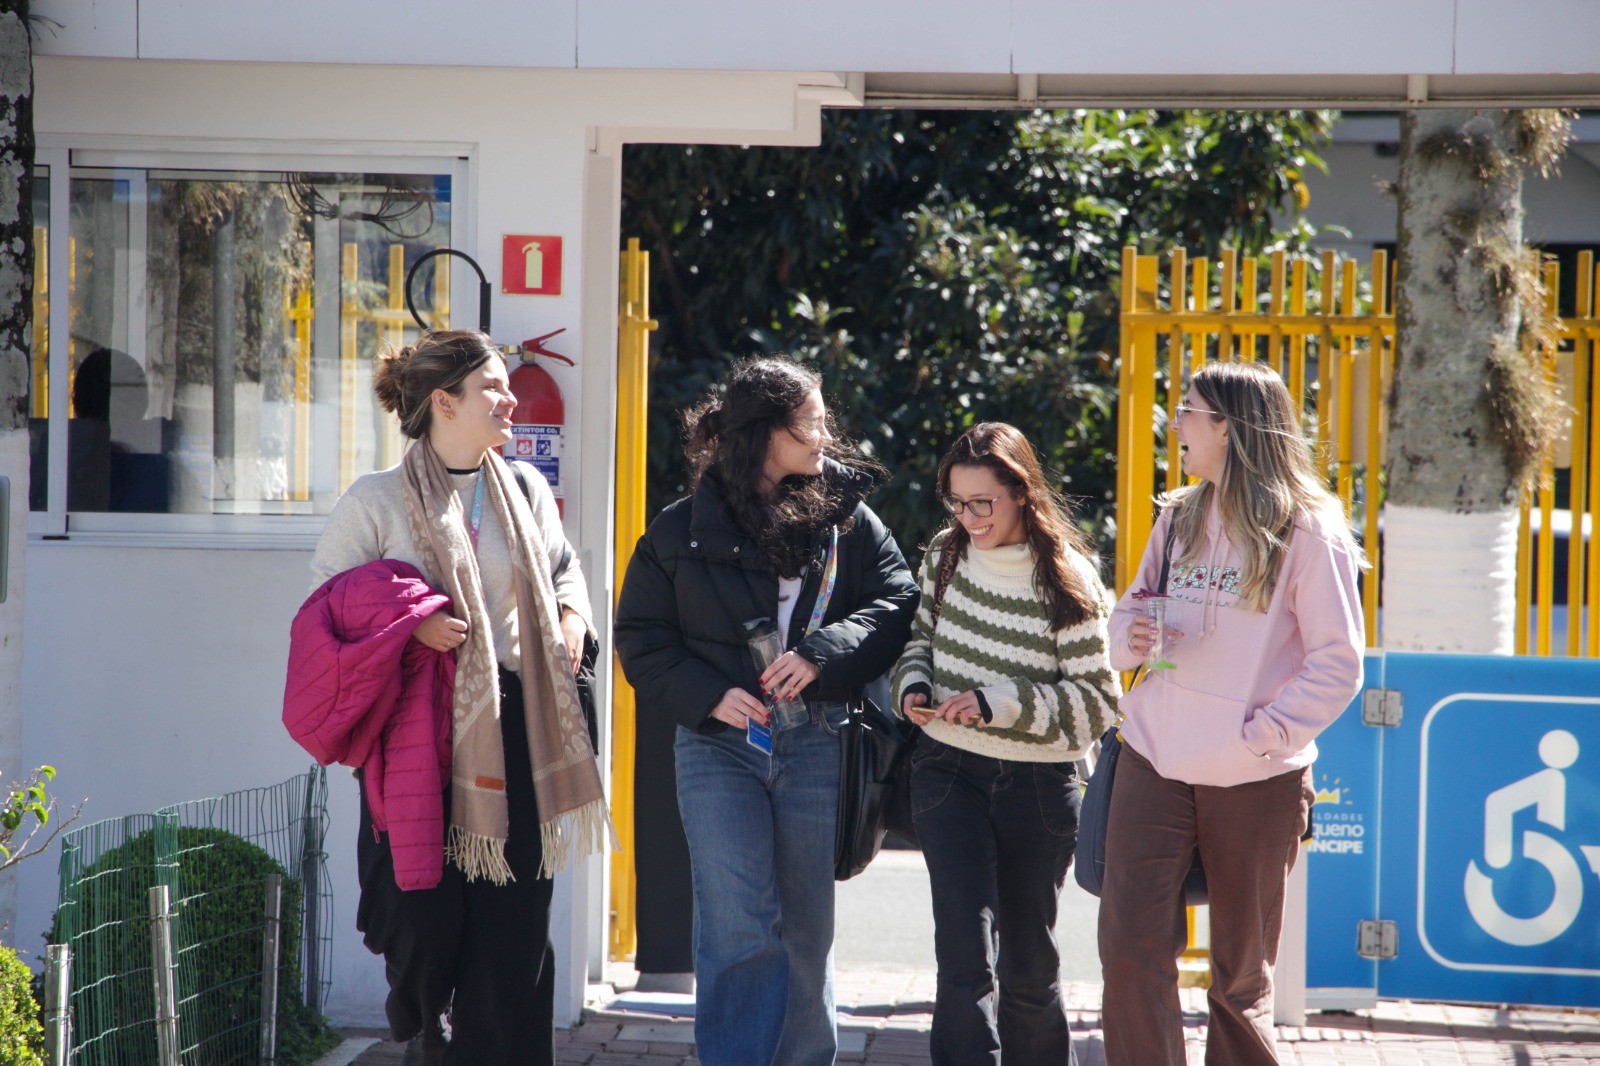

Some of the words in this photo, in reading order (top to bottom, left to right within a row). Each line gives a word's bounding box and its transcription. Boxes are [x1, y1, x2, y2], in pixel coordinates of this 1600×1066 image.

[511, 426, 545, 434] XTINTOR
[1312, 812, 1363, 821] LDADES
[1312, 823, 1364, 839] queno
